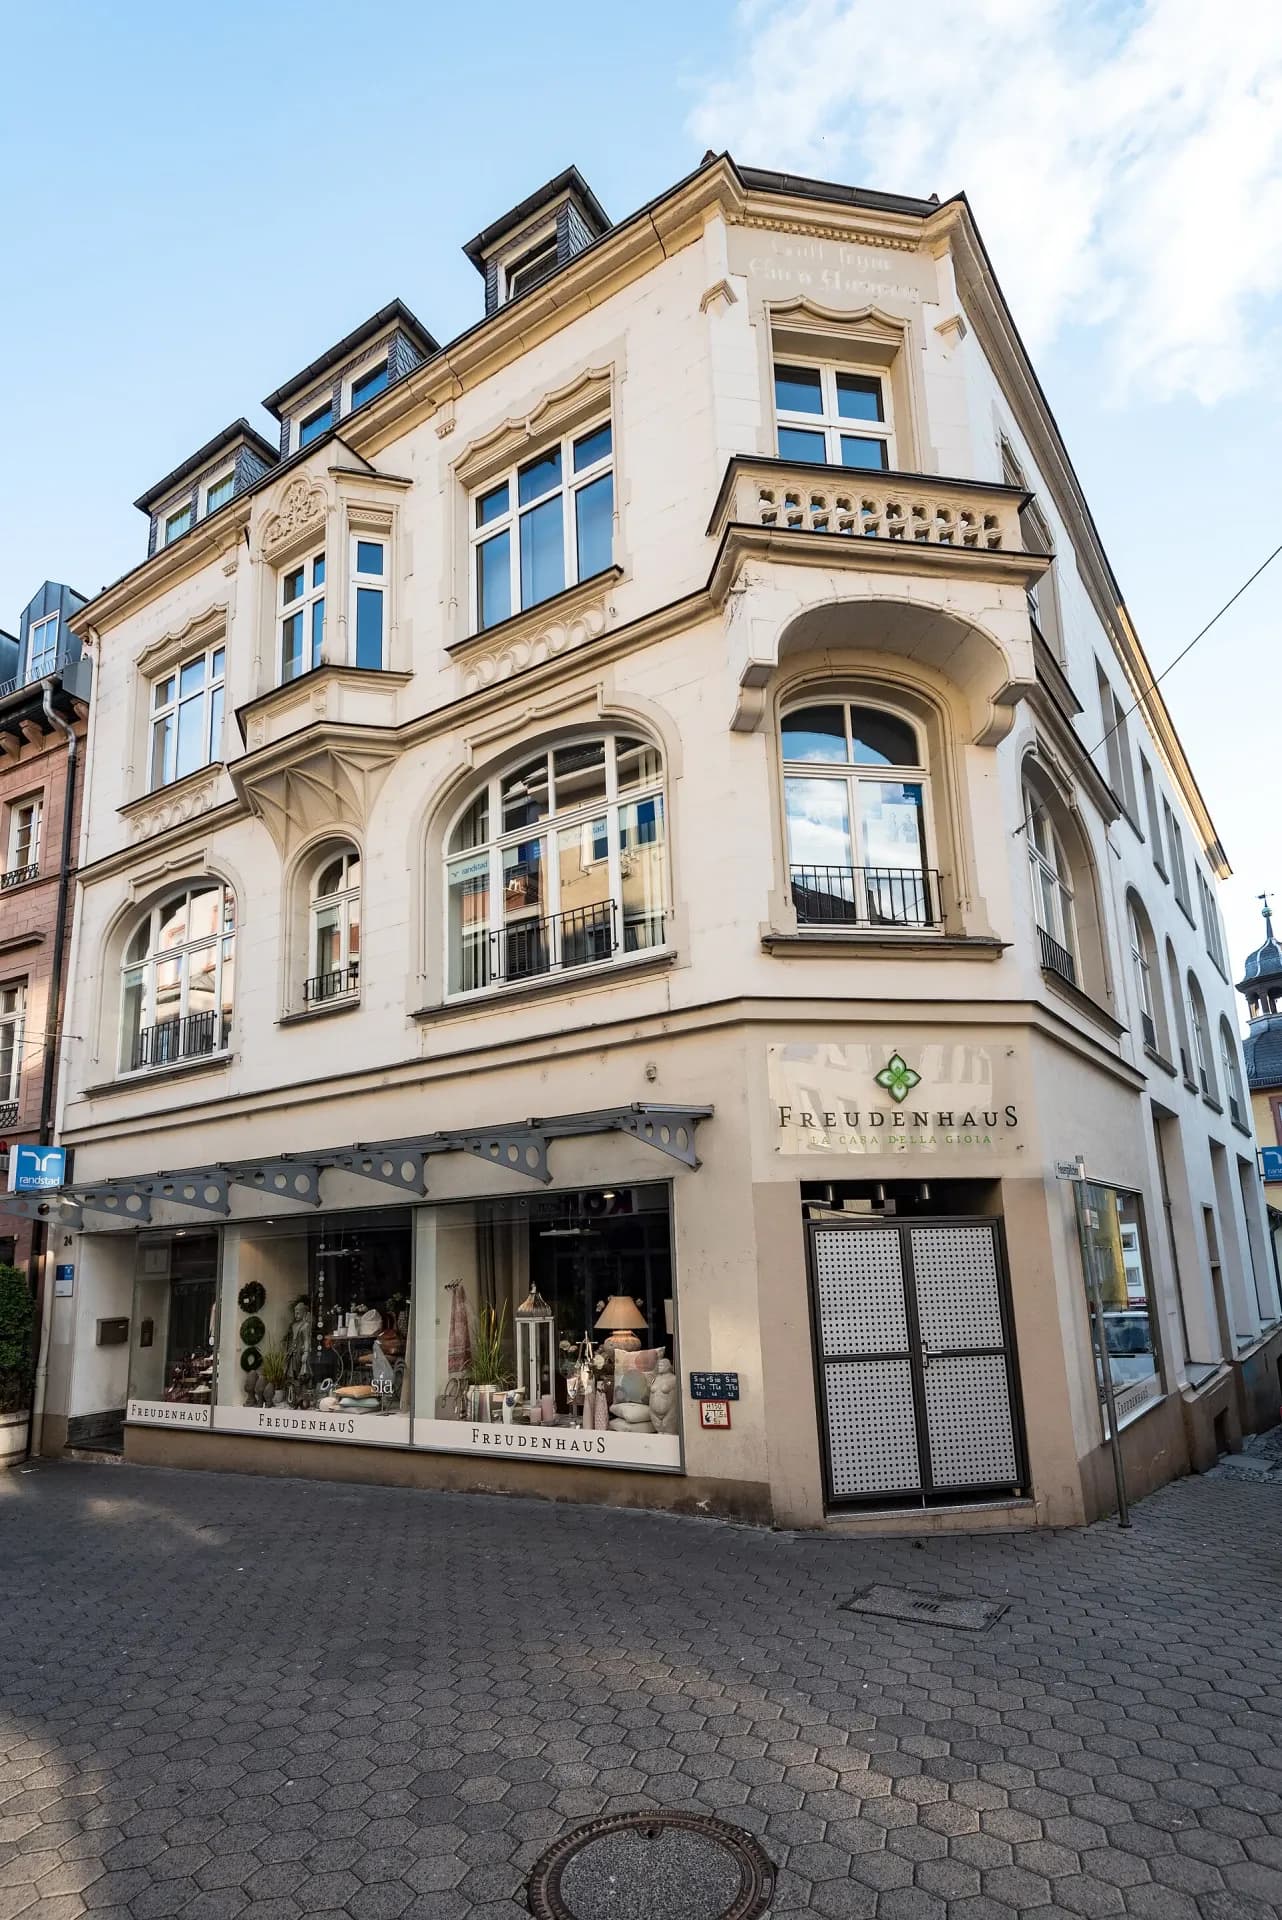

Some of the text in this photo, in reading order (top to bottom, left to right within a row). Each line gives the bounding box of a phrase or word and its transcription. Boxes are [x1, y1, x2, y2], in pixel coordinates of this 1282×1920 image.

[778, 1105, 1018, 1128] FREUDENHAUS
[811, 1135, 992, 1145] LA CASA DELLA GIOIA
[19, 1175, 60, 1186] randstad
[371, 1374, 394, 1394] sia
[131, 1403, 208, 1422] FREUDENHAUS
[258, 1413, 354, 1434] FREUDENHAUS
[471, 1428, 606, 1454] FREUDENHAUS
